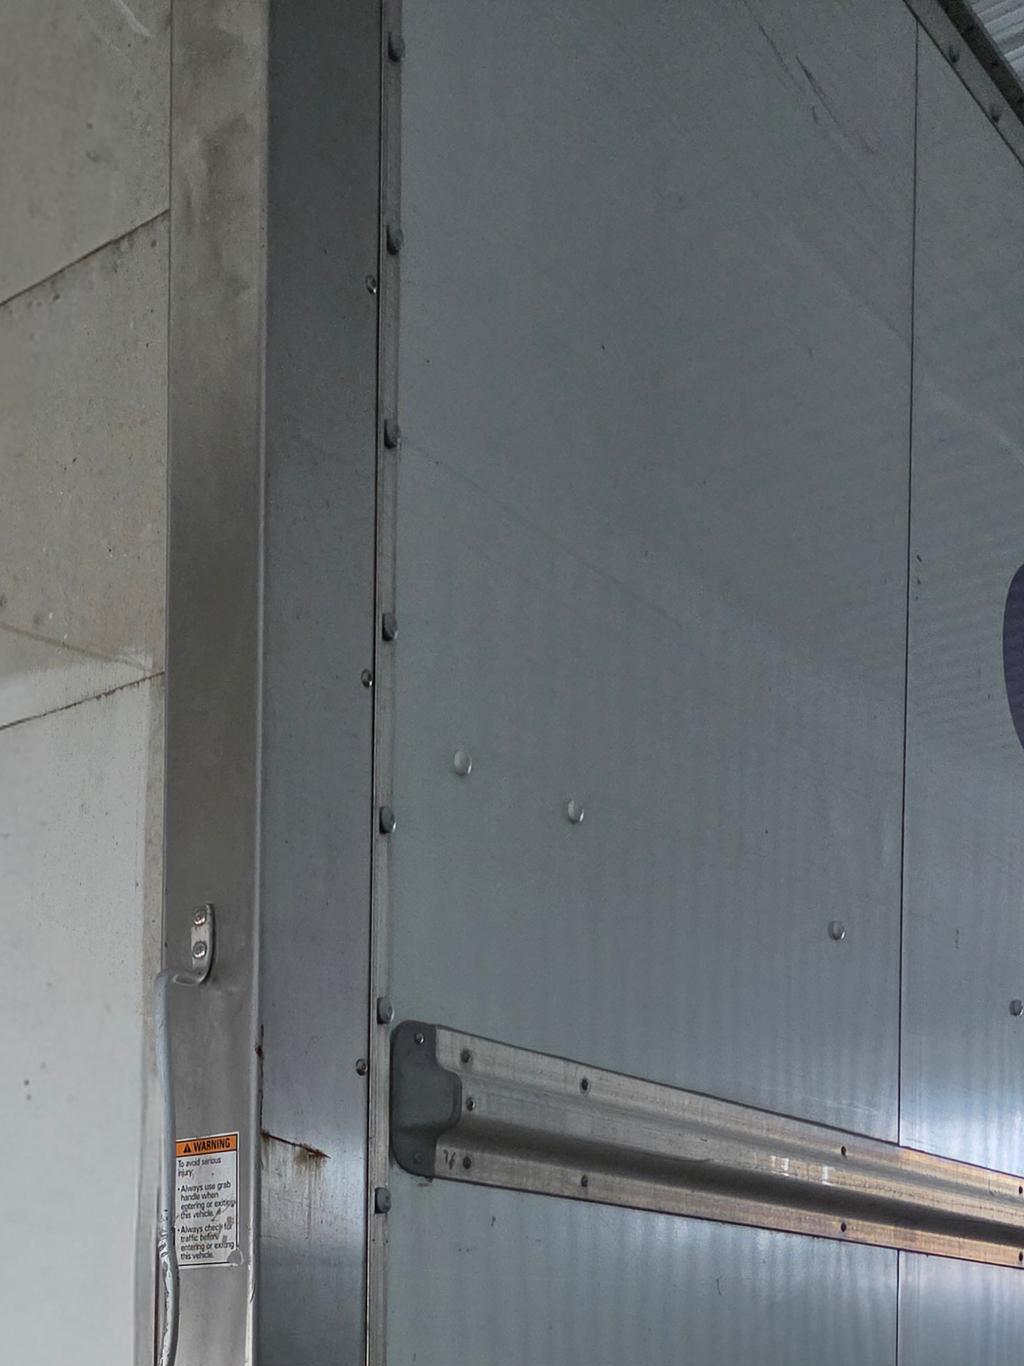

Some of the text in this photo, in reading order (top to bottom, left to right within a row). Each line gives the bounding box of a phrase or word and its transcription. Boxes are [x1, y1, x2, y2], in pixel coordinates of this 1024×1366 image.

[194, 1138, 230, 1152] WARNING
[178, 1158, 221, 1168] To avoid serious
[181, 1185, 204, 1193] Always
[218, 1181, 231, 1191] grab
[181, 1191, 219, 1201] handle when
[181, 1202, 205, 1212] entering
[214, 1199, 235, 1208] exiting
[181, 1210, 214, 1219] this vehicle.
[181, 1222, 233, 1234] Always check for
[181, 1232, 219, 1242] traffic before
[181, 1243, 205, 1252] entering
[214, 1240, 235, 1250] exiting
[181, 1250, 214, 1260] this vehicle.
